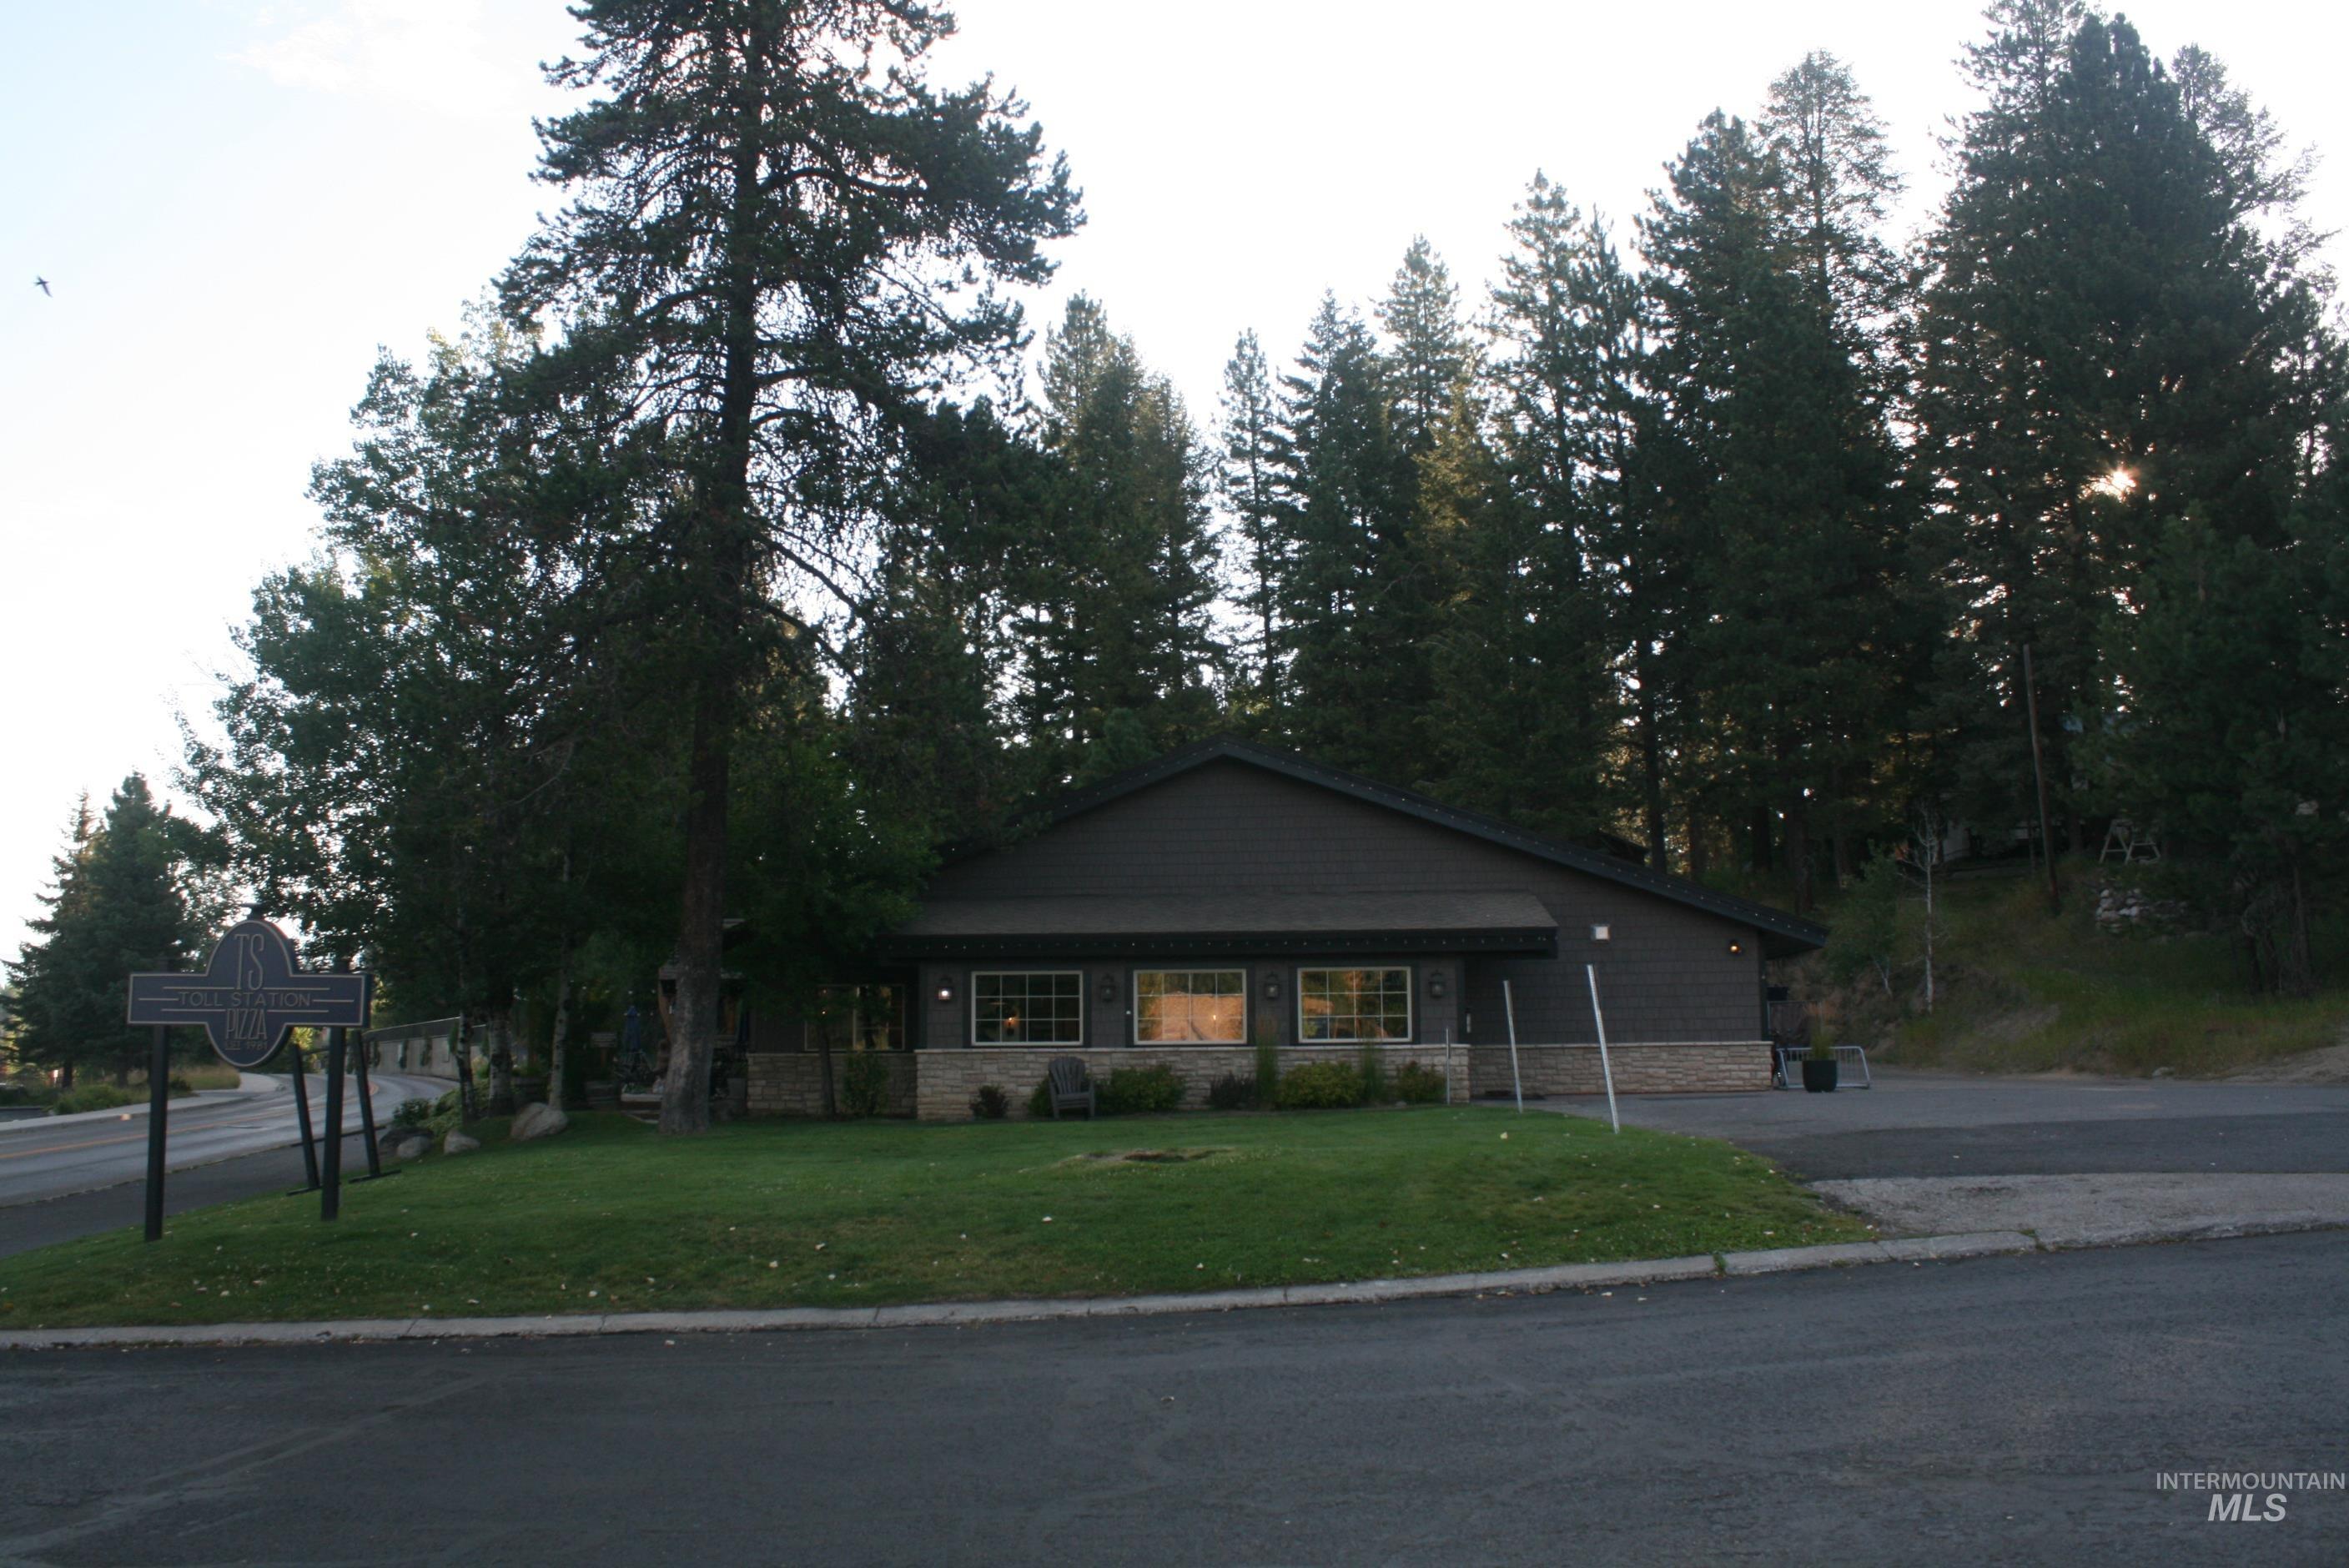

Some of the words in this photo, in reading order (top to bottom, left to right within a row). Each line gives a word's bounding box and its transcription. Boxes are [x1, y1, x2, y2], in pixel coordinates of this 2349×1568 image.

[233, 933, 265, 991] TS
[179, 991, 224, 1007] TOLL
[230, 991, 311, 1008] STATION
[225, 1008, 268, 1040] PIZZA
